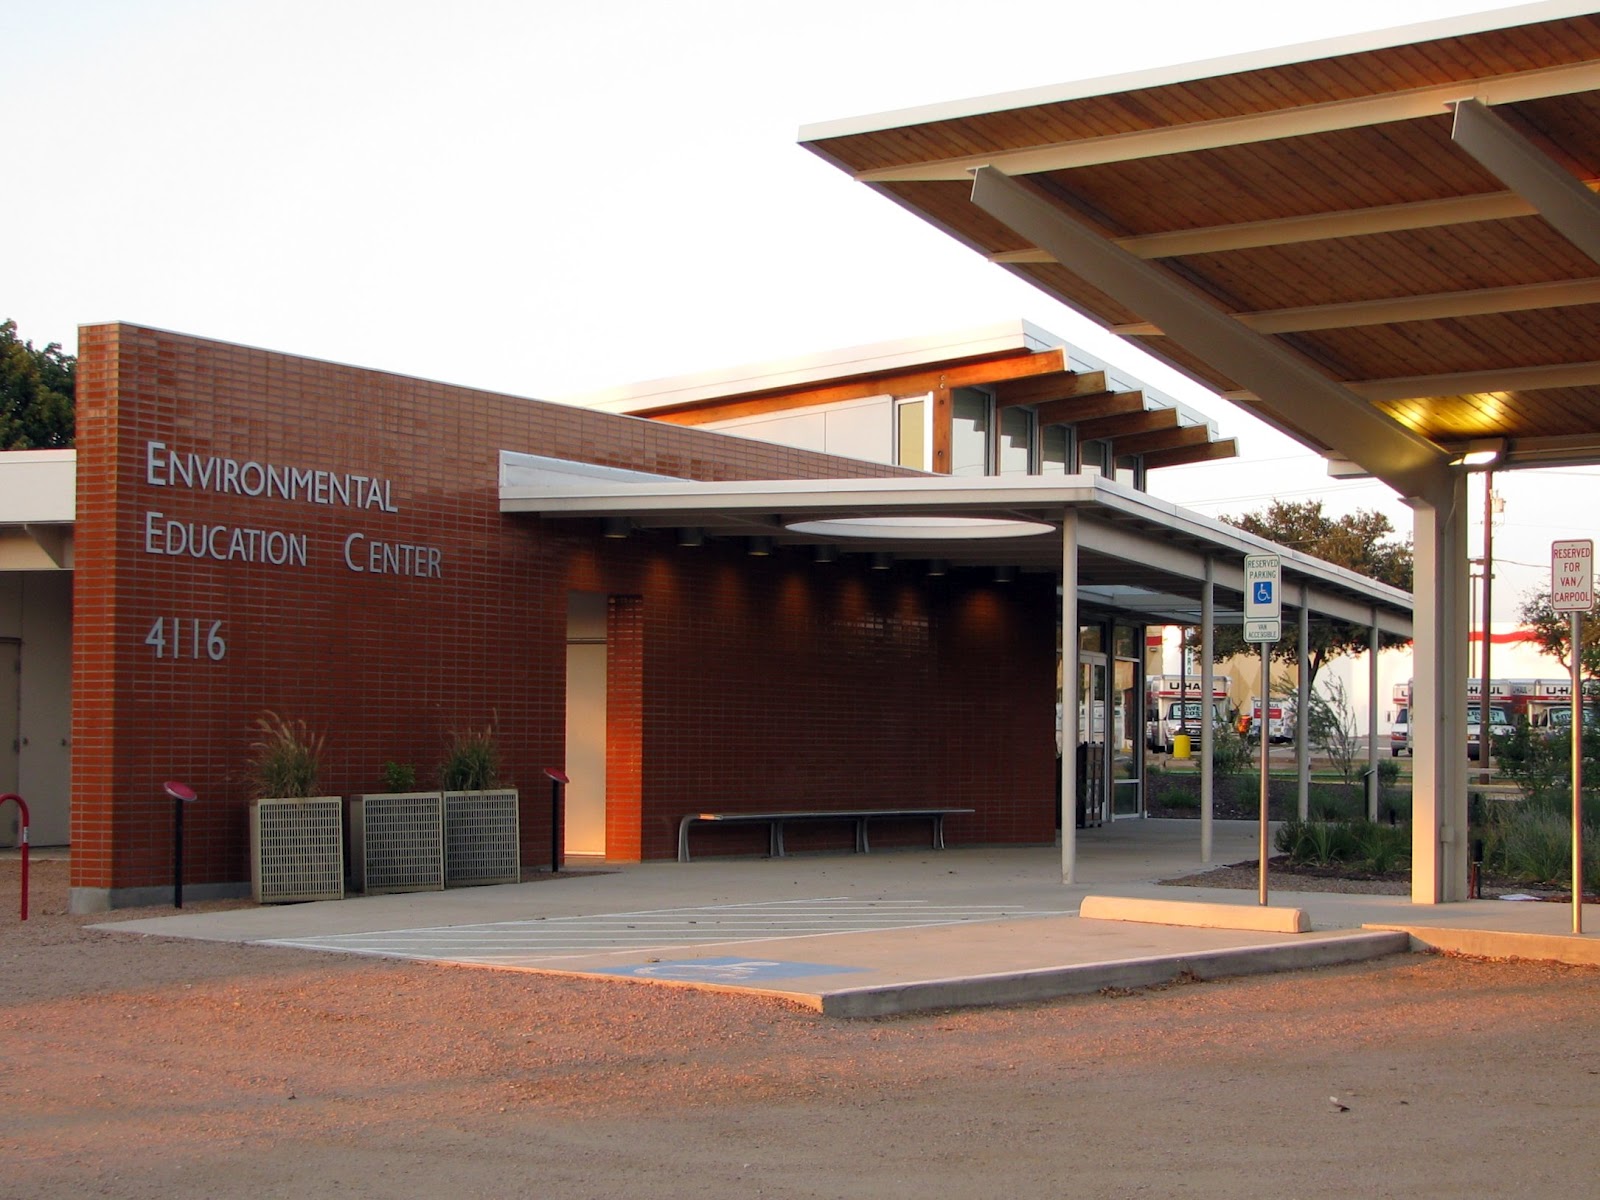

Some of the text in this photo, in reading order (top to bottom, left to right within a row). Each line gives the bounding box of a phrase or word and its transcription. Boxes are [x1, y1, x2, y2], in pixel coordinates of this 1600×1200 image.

[146, 440, 398, 513] ENVIRONMENTAL
[144, 511, 441, 579] EDUCATION CENTER
[1553, 548, 1591, 559] RESERVED
[1247, 559, 1278, 569] RESERVED
[1563, 562, 1580, 572] FOR
[1249, 570, 1277, 579] PARKING
[1560, 576, 1584, 587] VAN/
[1554, 592, 1590, 603] CARPOOL
[145, 616, 226, 661] 4116
[1248, 631, 1277, 639] ACCESSIBLE
